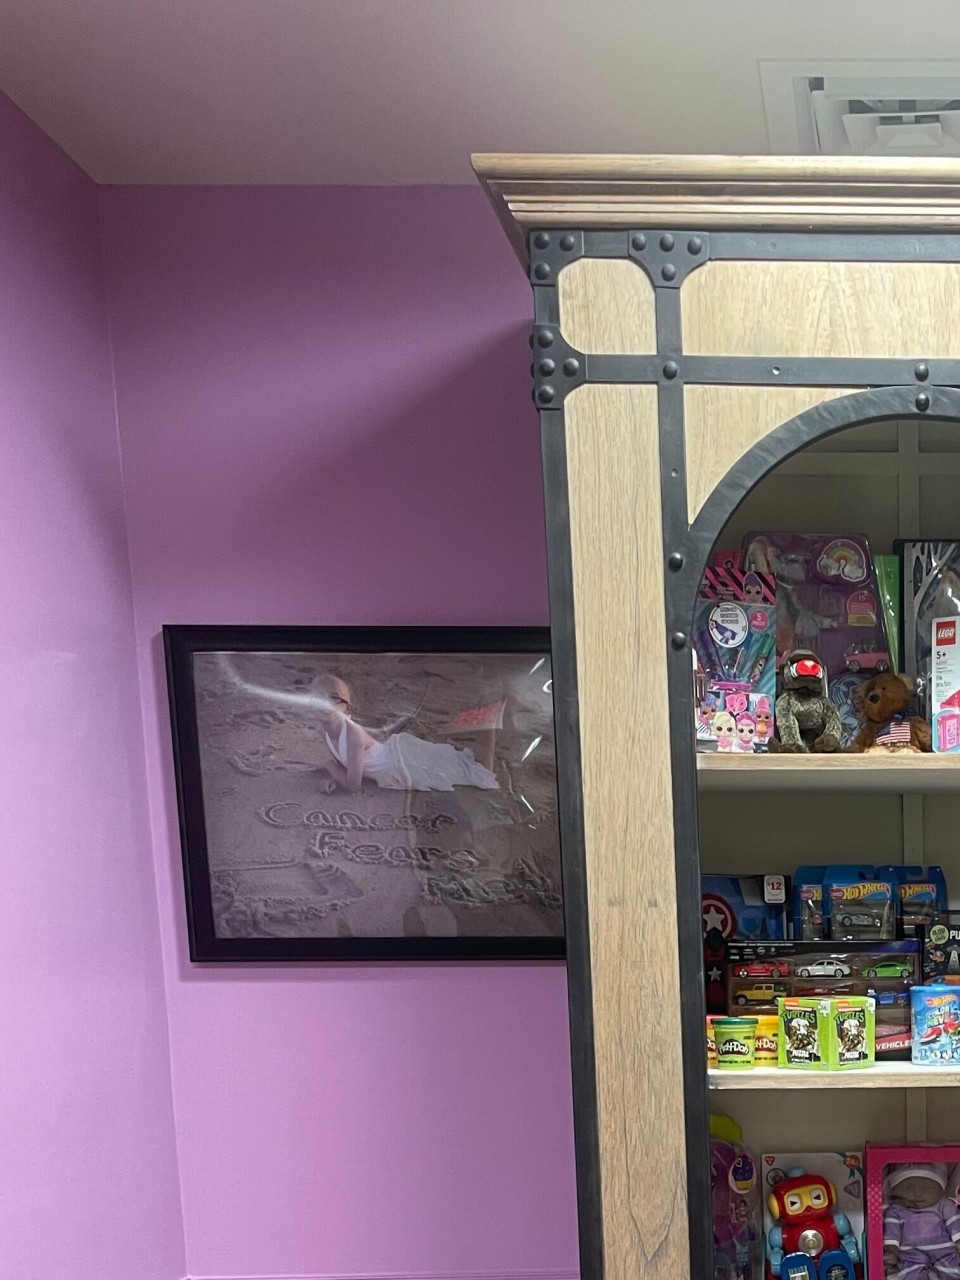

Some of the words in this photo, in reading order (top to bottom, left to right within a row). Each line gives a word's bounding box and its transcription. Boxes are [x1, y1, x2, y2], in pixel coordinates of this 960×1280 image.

[938, 628, 954, 638] LEGO
[936, 651, 946, 660] 5+
[263, 801, 459, 832] Cancer
[311, 830, 481, 870] Fears
[844, 886, 860, 900] HOT
[860, 882, 888, 896] WHEELS
[782, 1010, 816, 1024] TURTLES
[834, 1012, 865, 1024] TURTLES
